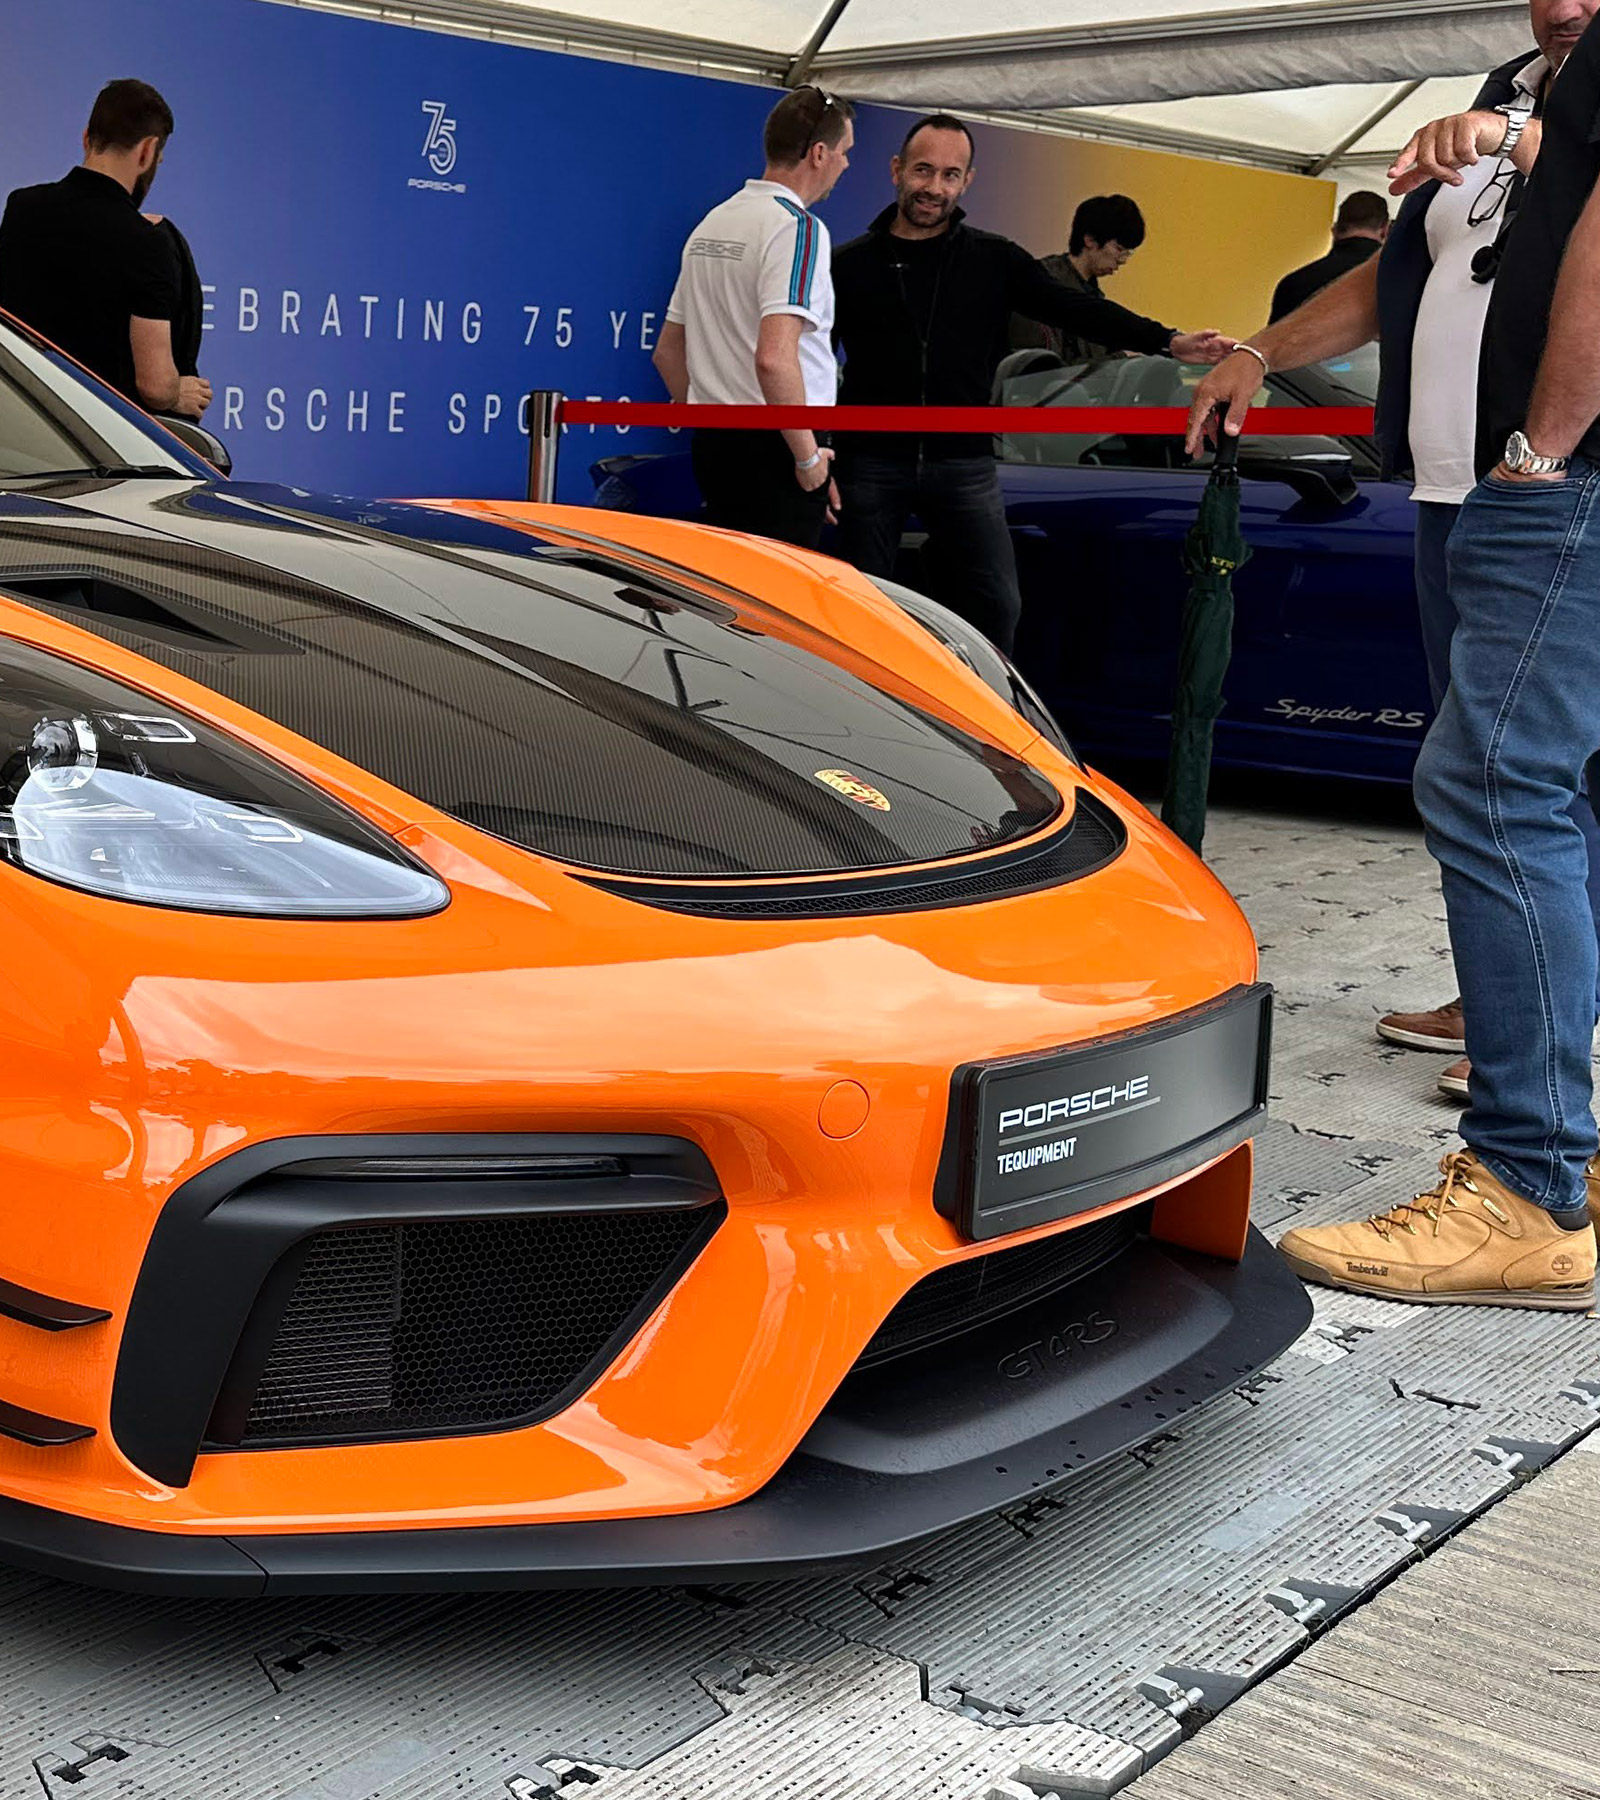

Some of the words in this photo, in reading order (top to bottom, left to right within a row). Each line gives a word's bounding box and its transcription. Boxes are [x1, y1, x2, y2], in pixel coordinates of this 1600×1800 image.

[421, 100, 457, 175] 75
[523, 305, 573, 348] 75
[1264, 699, 1372, 723] Spyder
[1373, 708, 1426, 728] RS
[998, 1075, 1149, 1133] PORSCHE
[997, 1137, 1077, 1175] TEQUIPMENT
